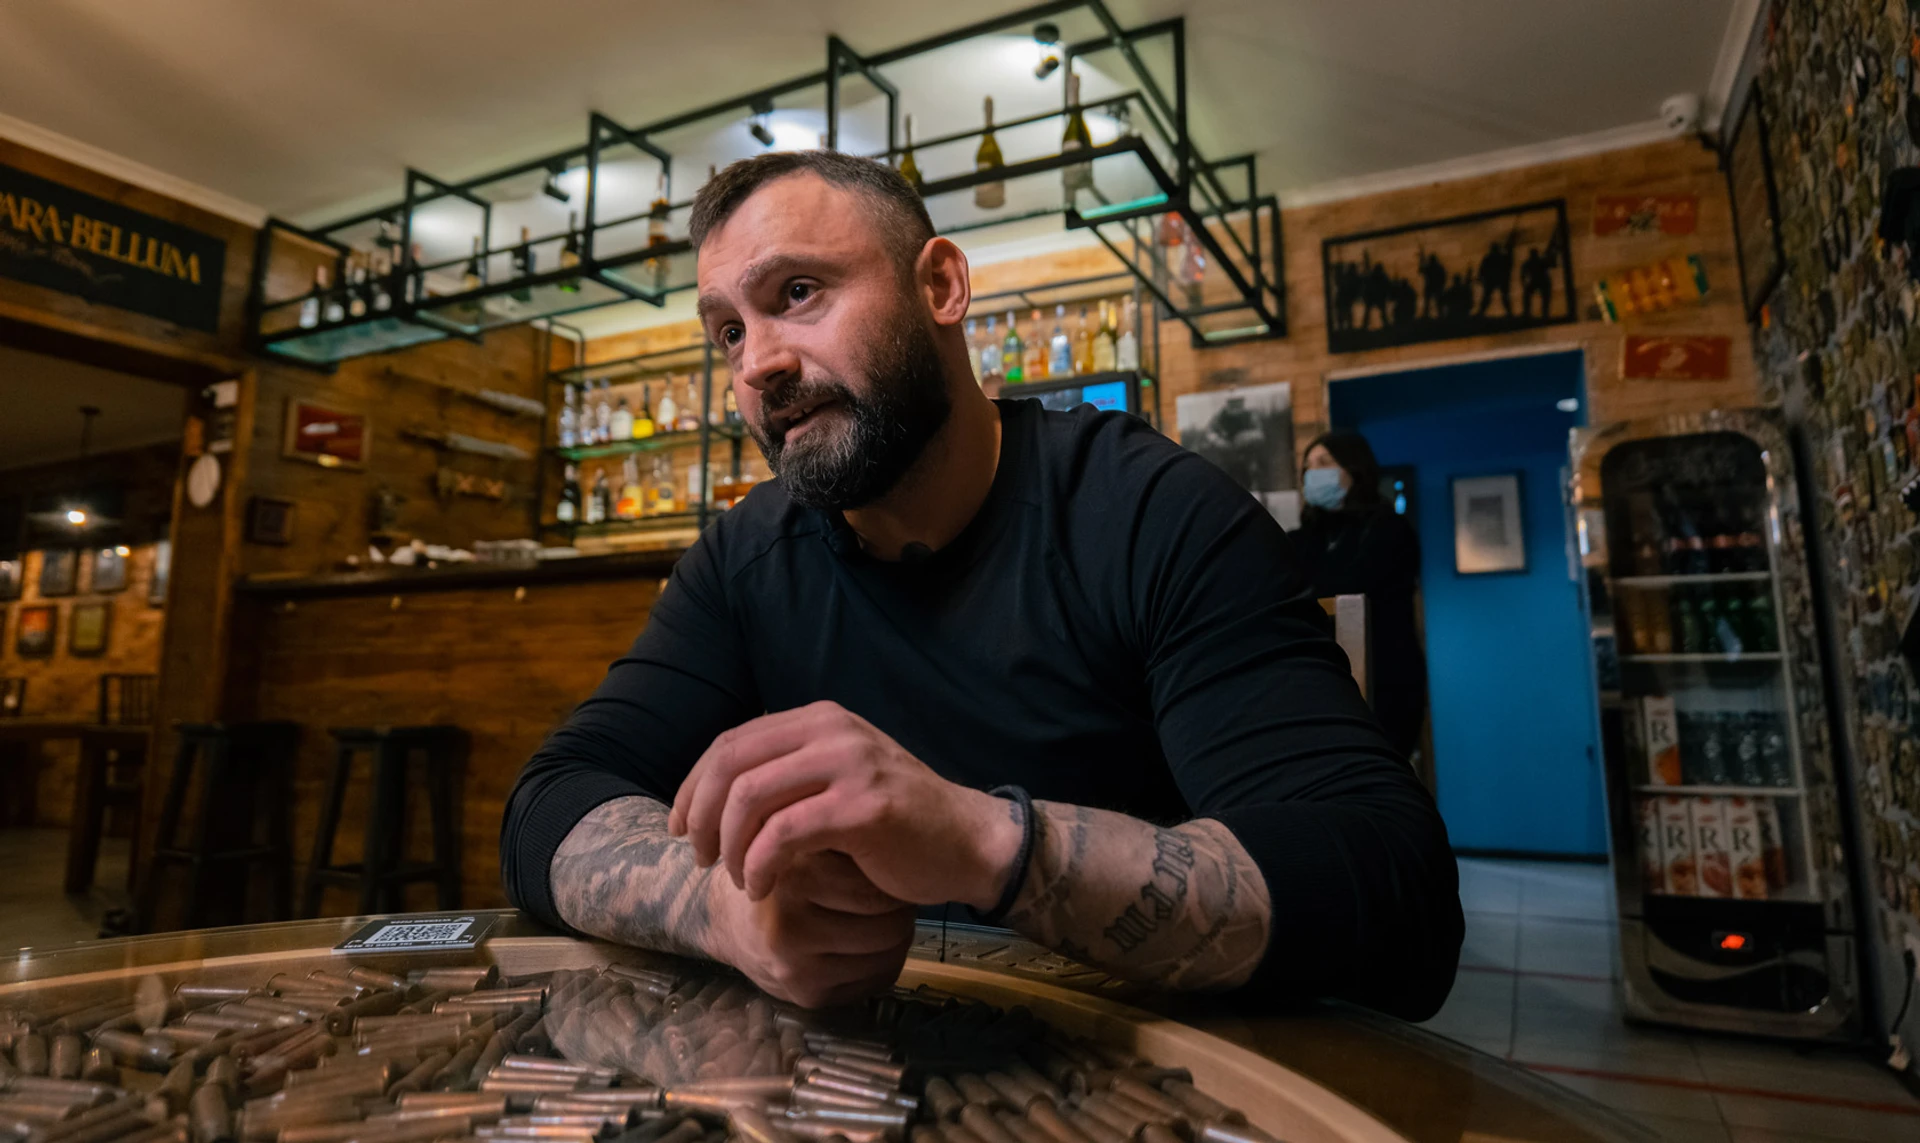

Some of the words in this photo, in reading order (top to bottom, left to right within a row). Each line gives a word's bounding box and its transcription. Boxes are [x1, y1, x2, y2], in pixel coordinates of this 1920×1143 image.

[1666, 825, 1689, 849] R
[1700, 826, 1722, 850] R
[1732, 827, 1755, 851] R
